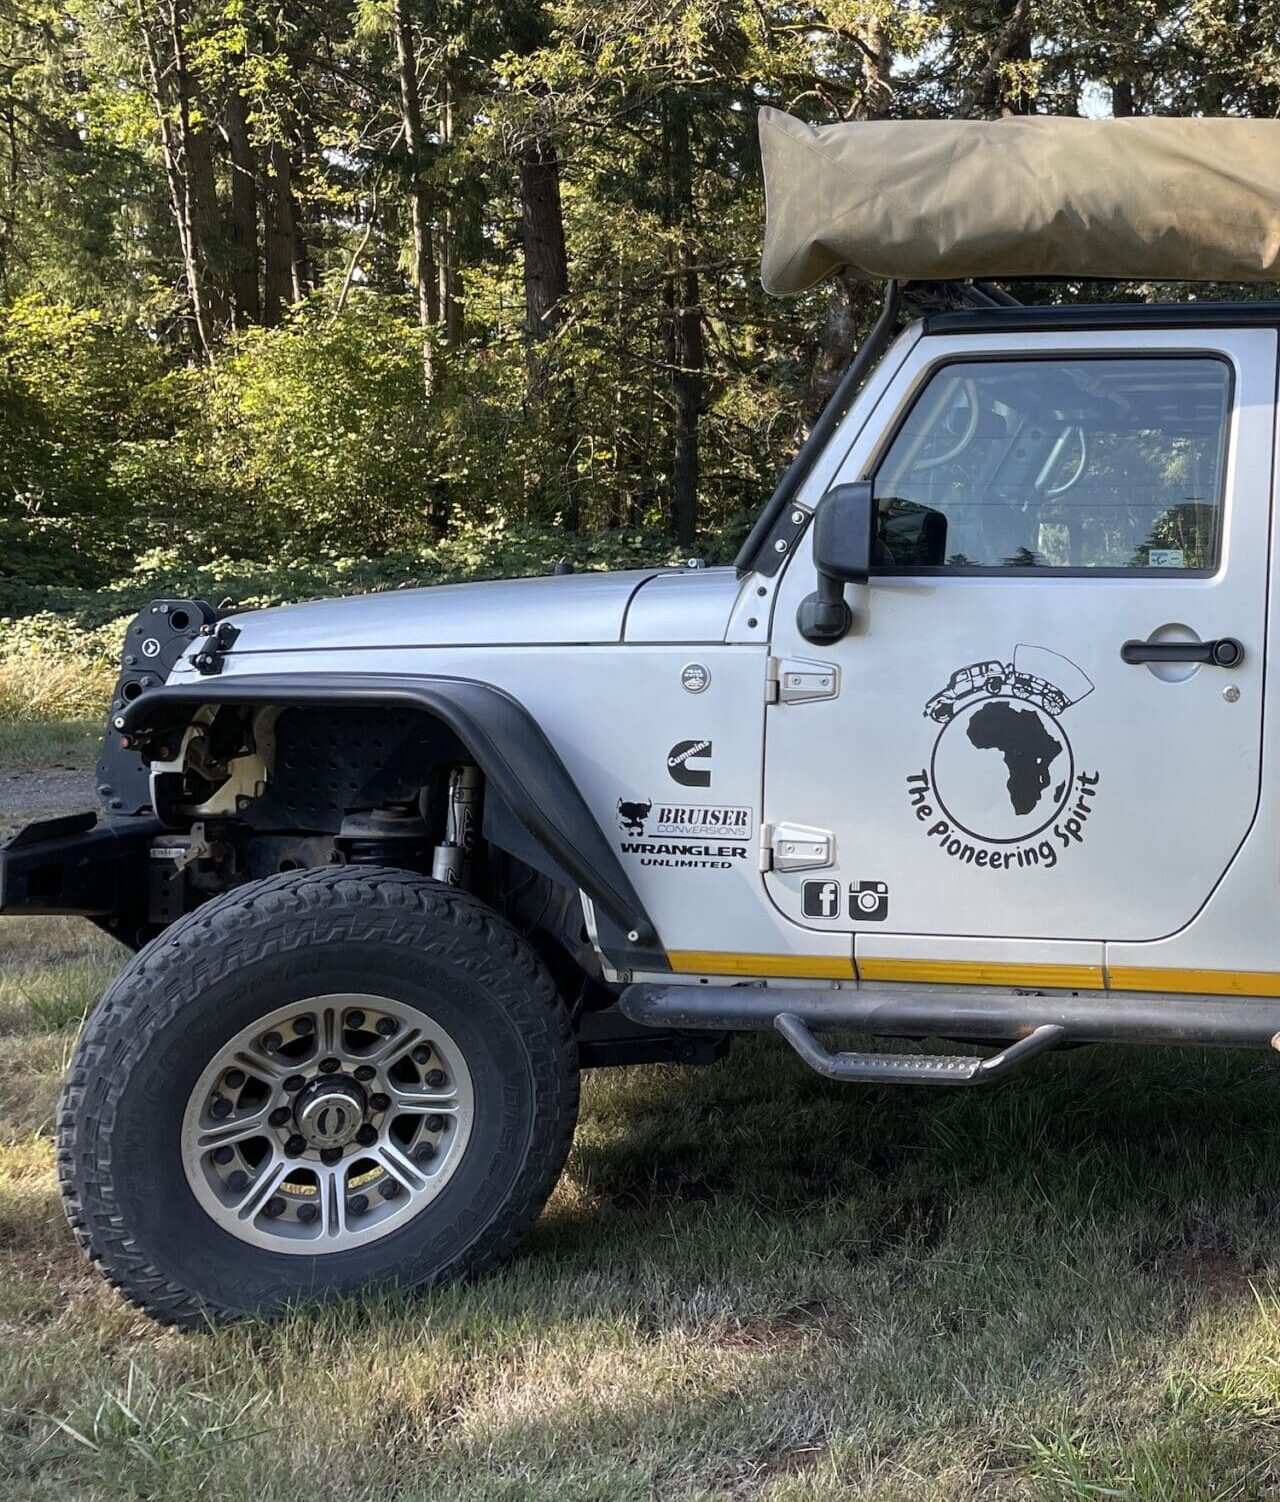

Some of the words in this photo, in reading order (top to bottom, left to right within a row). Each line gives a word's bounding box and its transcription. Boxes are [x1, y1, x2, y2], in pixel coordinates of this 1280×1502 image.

[668, 740, 711, 767] Cummins
[658, 808, 748, 826] BRUISER
[905, 768, 933, 822] The
[926, 820, 1058, 870] Pioneering
[1053, 770, 1101, 849] Spirit
[656, 824, 746, 836] CONVERSIONS
[620, 842, 748, 859] WRANGLER
[640, 858, 733, 869] UNLIMITED
